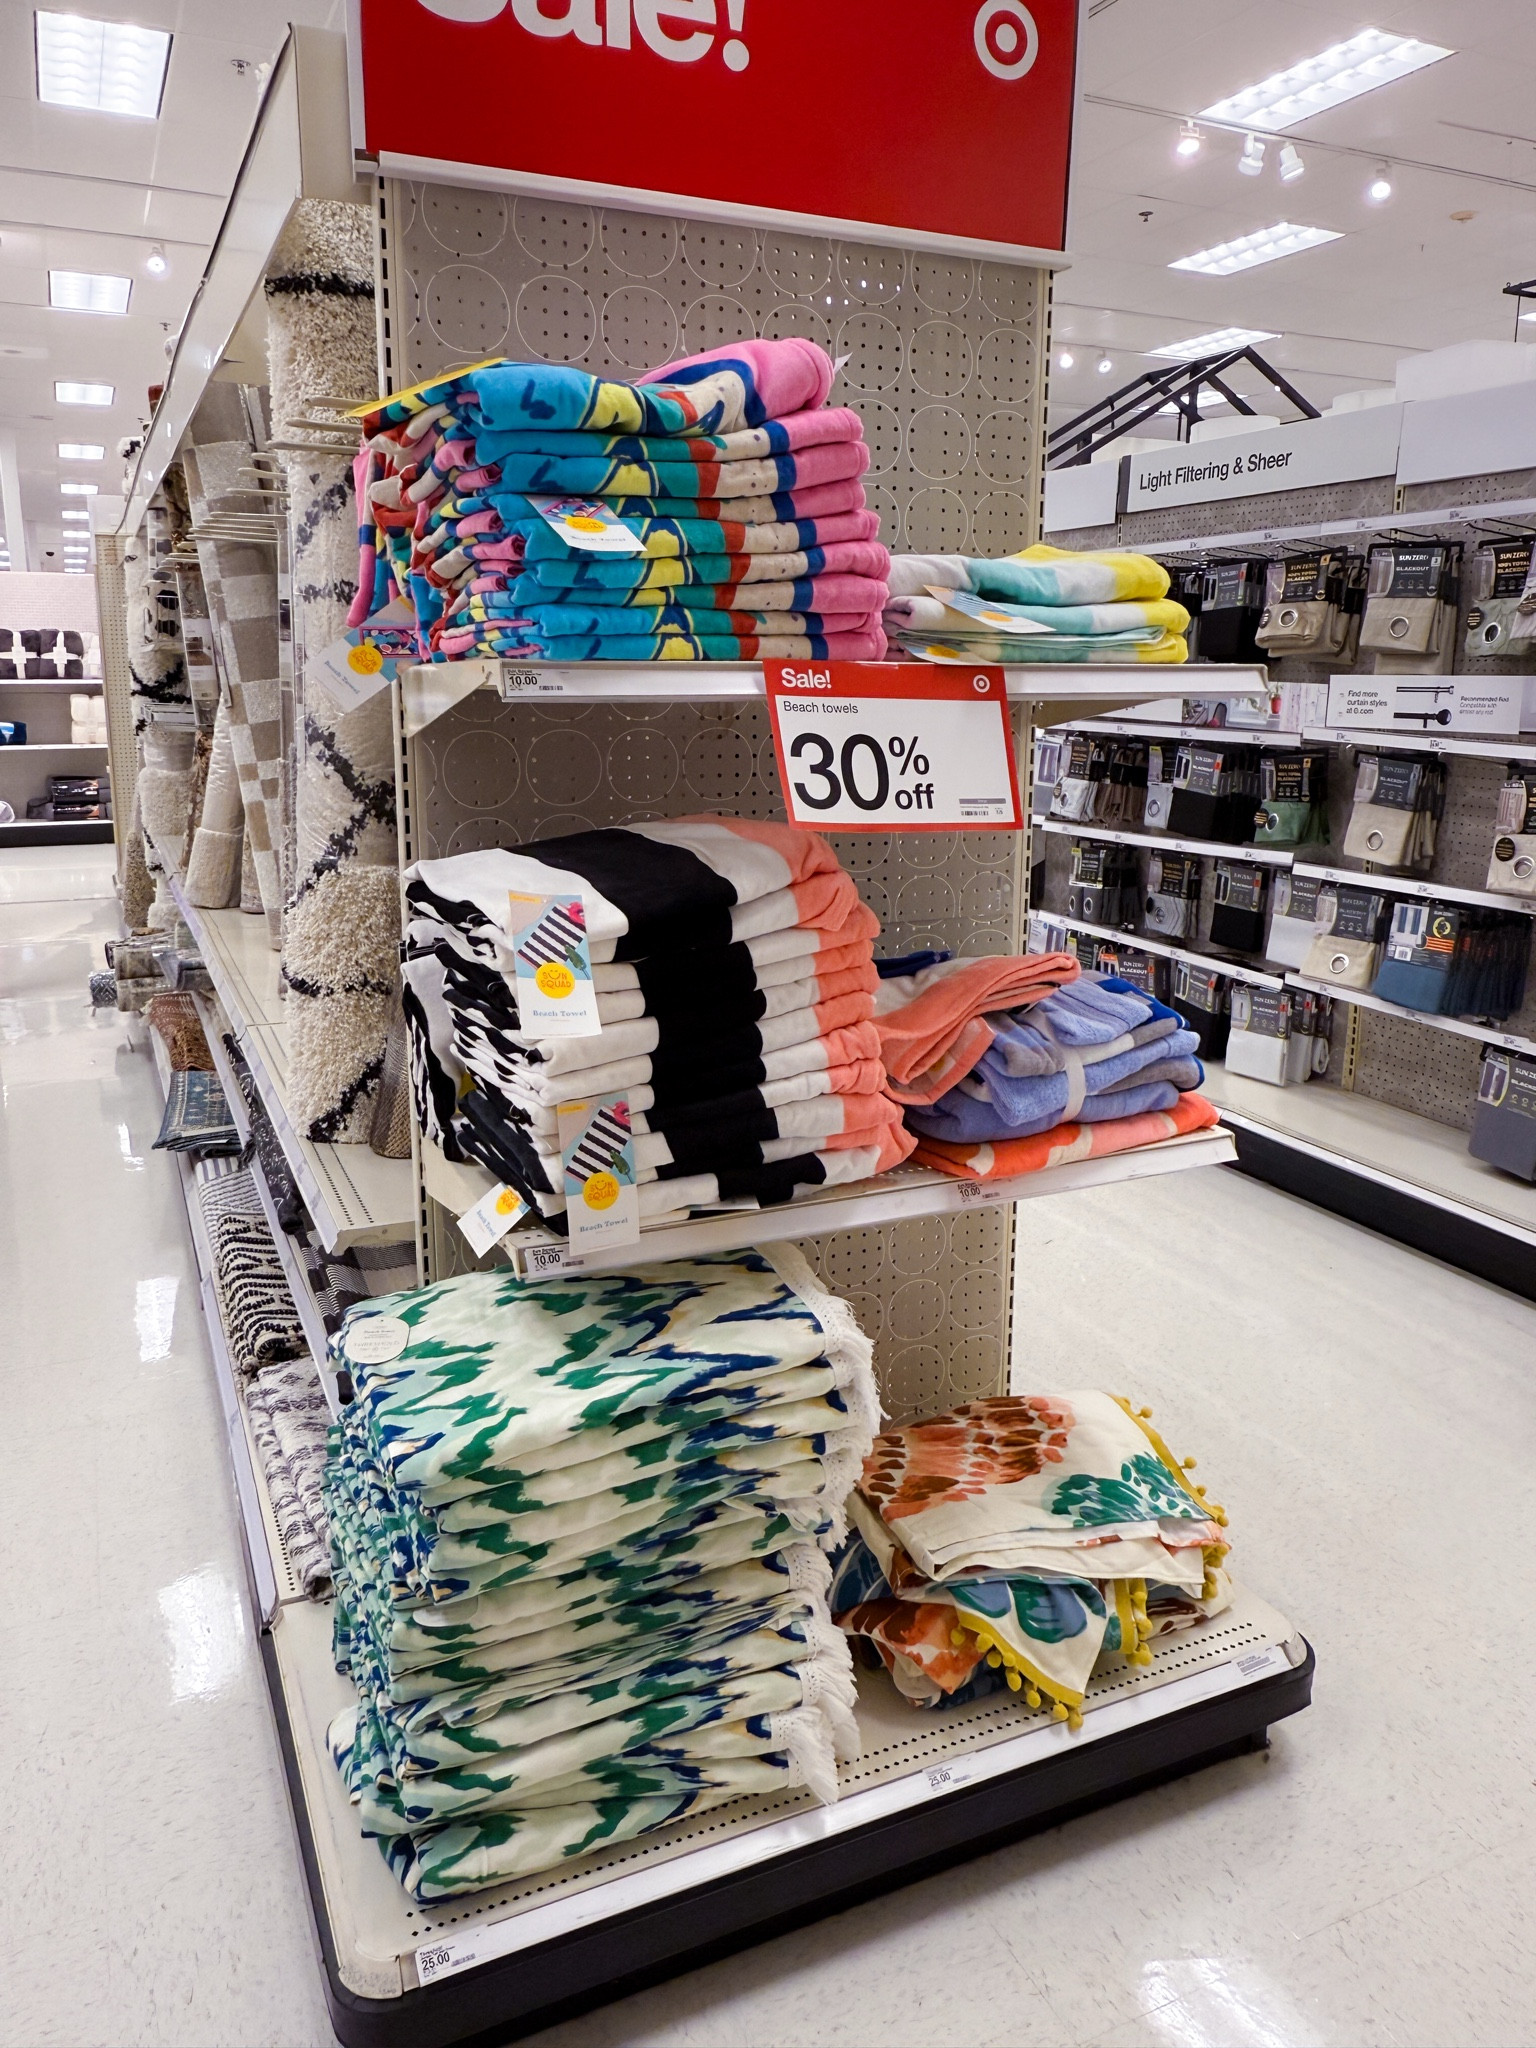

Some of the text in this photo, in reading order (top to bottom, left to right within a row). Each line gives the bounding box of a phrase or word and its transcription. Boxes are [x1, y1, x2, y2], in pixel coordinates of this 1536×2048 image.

[1139, 452, 1293, 492] Light Filtering & Sheer
[508, 676, 538, 686] 10.00
[781, 667, 832, 690] Sale!
[783, 700, 859, 714] Beach towels
[895, 783, 934, 810] off
[541, 979, 572, 991] SQUAD
[533, 1009, 587, 1018] Beach Towel
[588, 1189, 616, 1202] SQUAD
[960, 1186, 981, 1198] 10.00
[579, 1216, 629, 1233] Beach Towel
[534, 1253, 561, 1266] 10.00
[928, 1772, 951, 1787] 25.00
[421, 1951, 450, 1971] 25.00
